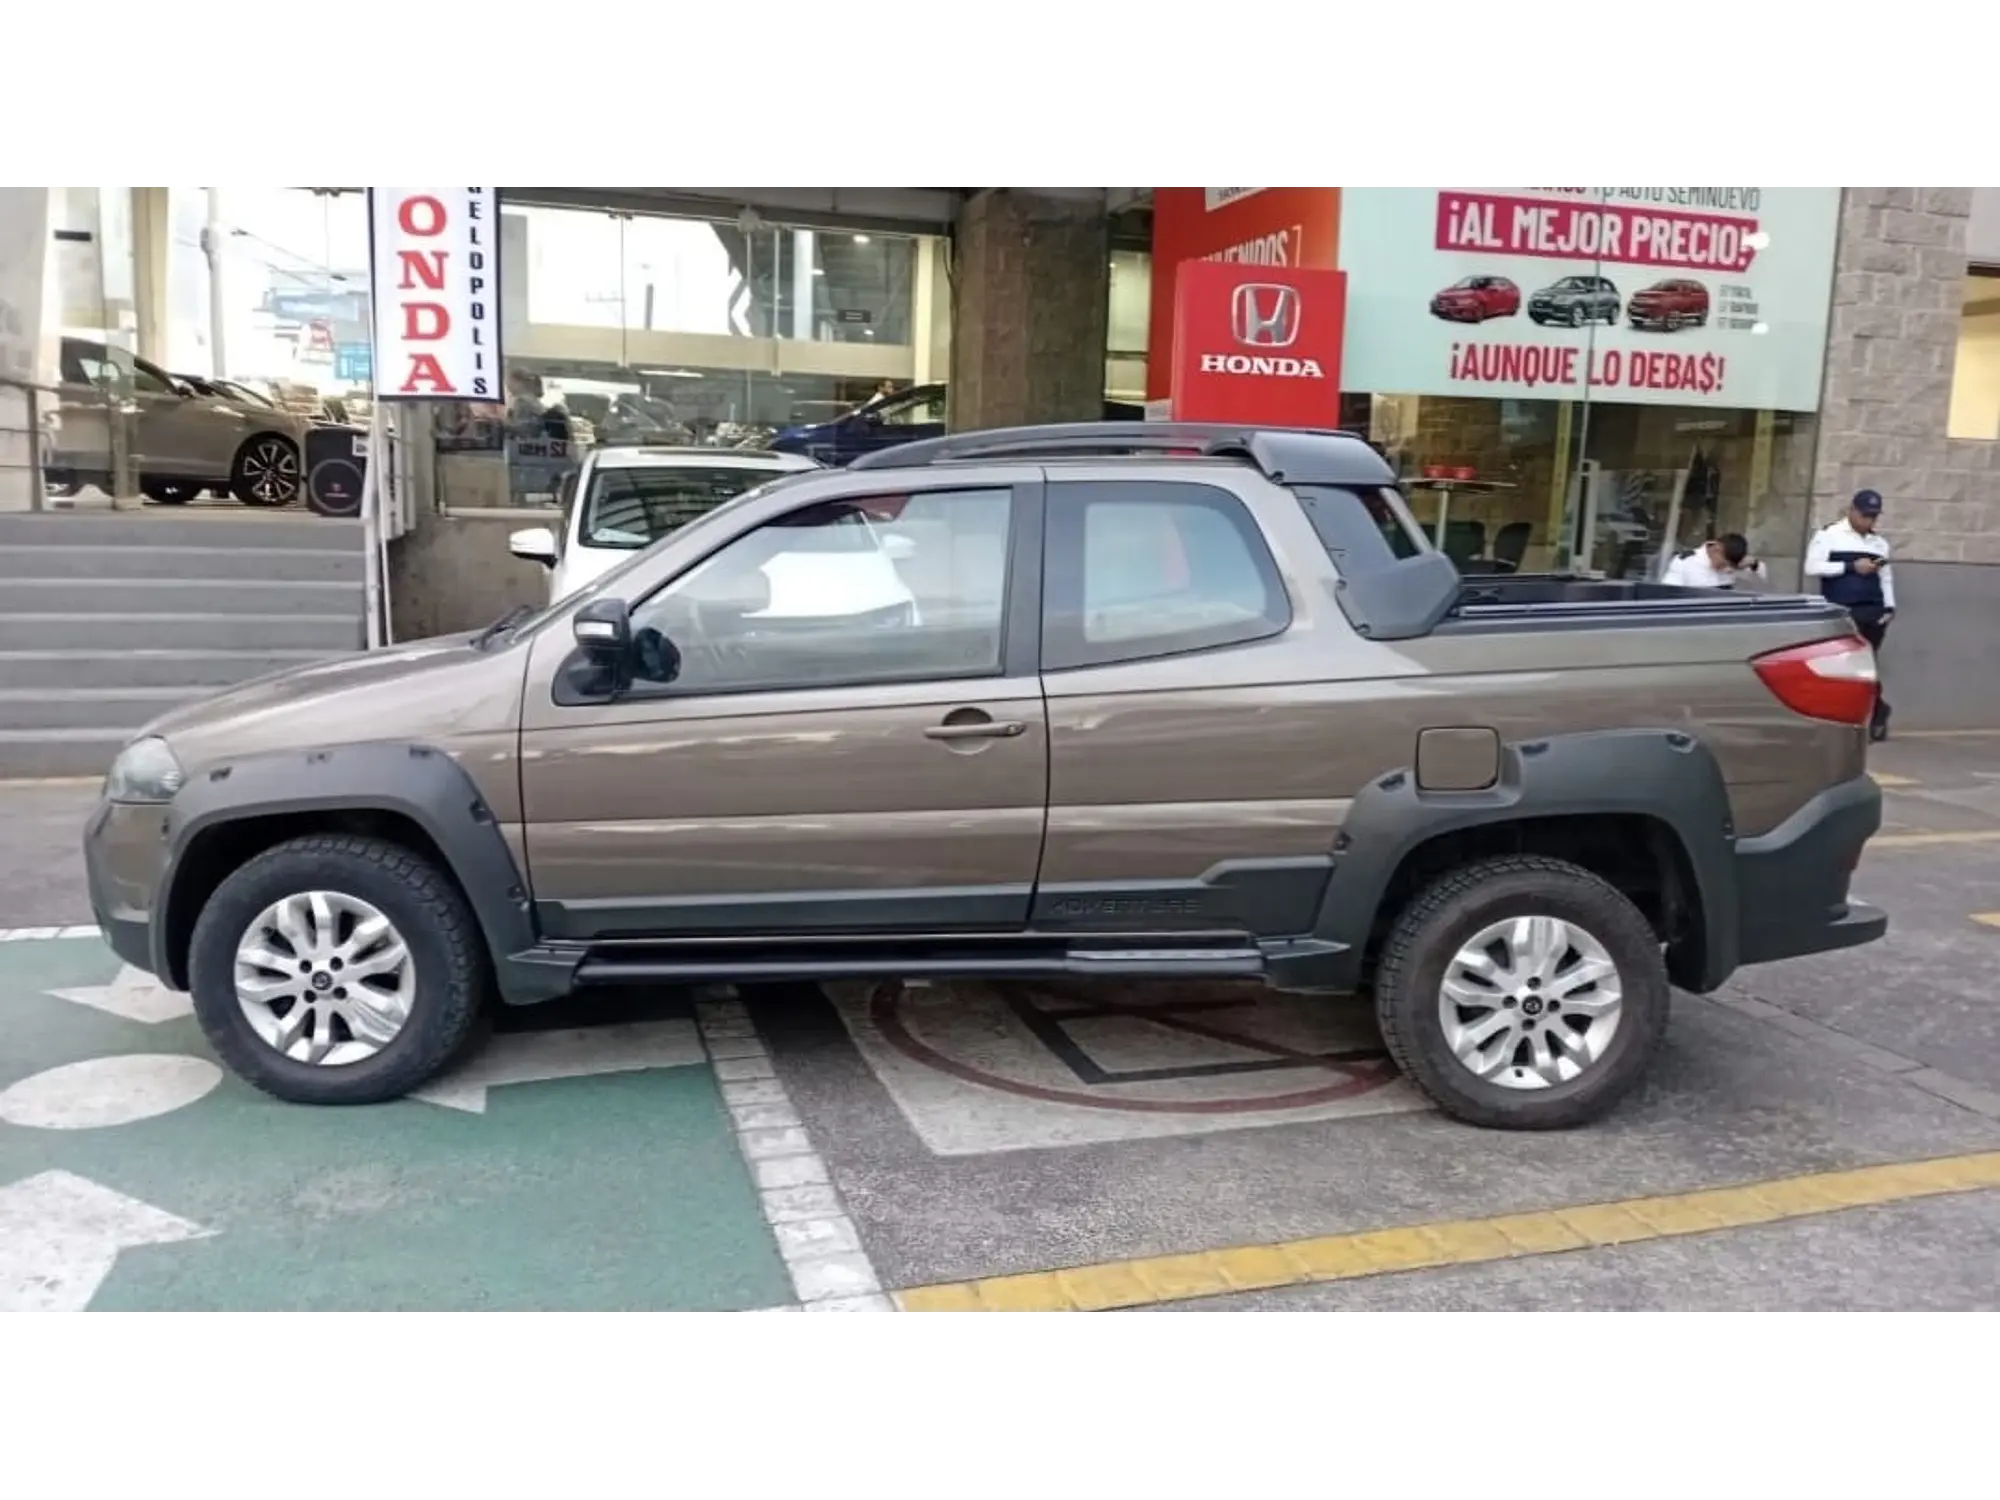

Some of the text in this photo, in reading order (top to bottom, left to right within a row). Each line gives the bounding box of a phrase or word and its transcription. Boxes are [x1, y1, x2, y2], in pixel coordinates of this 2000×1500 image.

[1511, 203, 1622, 258] MEJOR
[396, 194, 458, 393] ONDA
[1201, 353, 1325, 379] HONDA
[1450, 342, 1579, 388] ¡AUNQUE
[1586, 349, 1621, 386] LO
